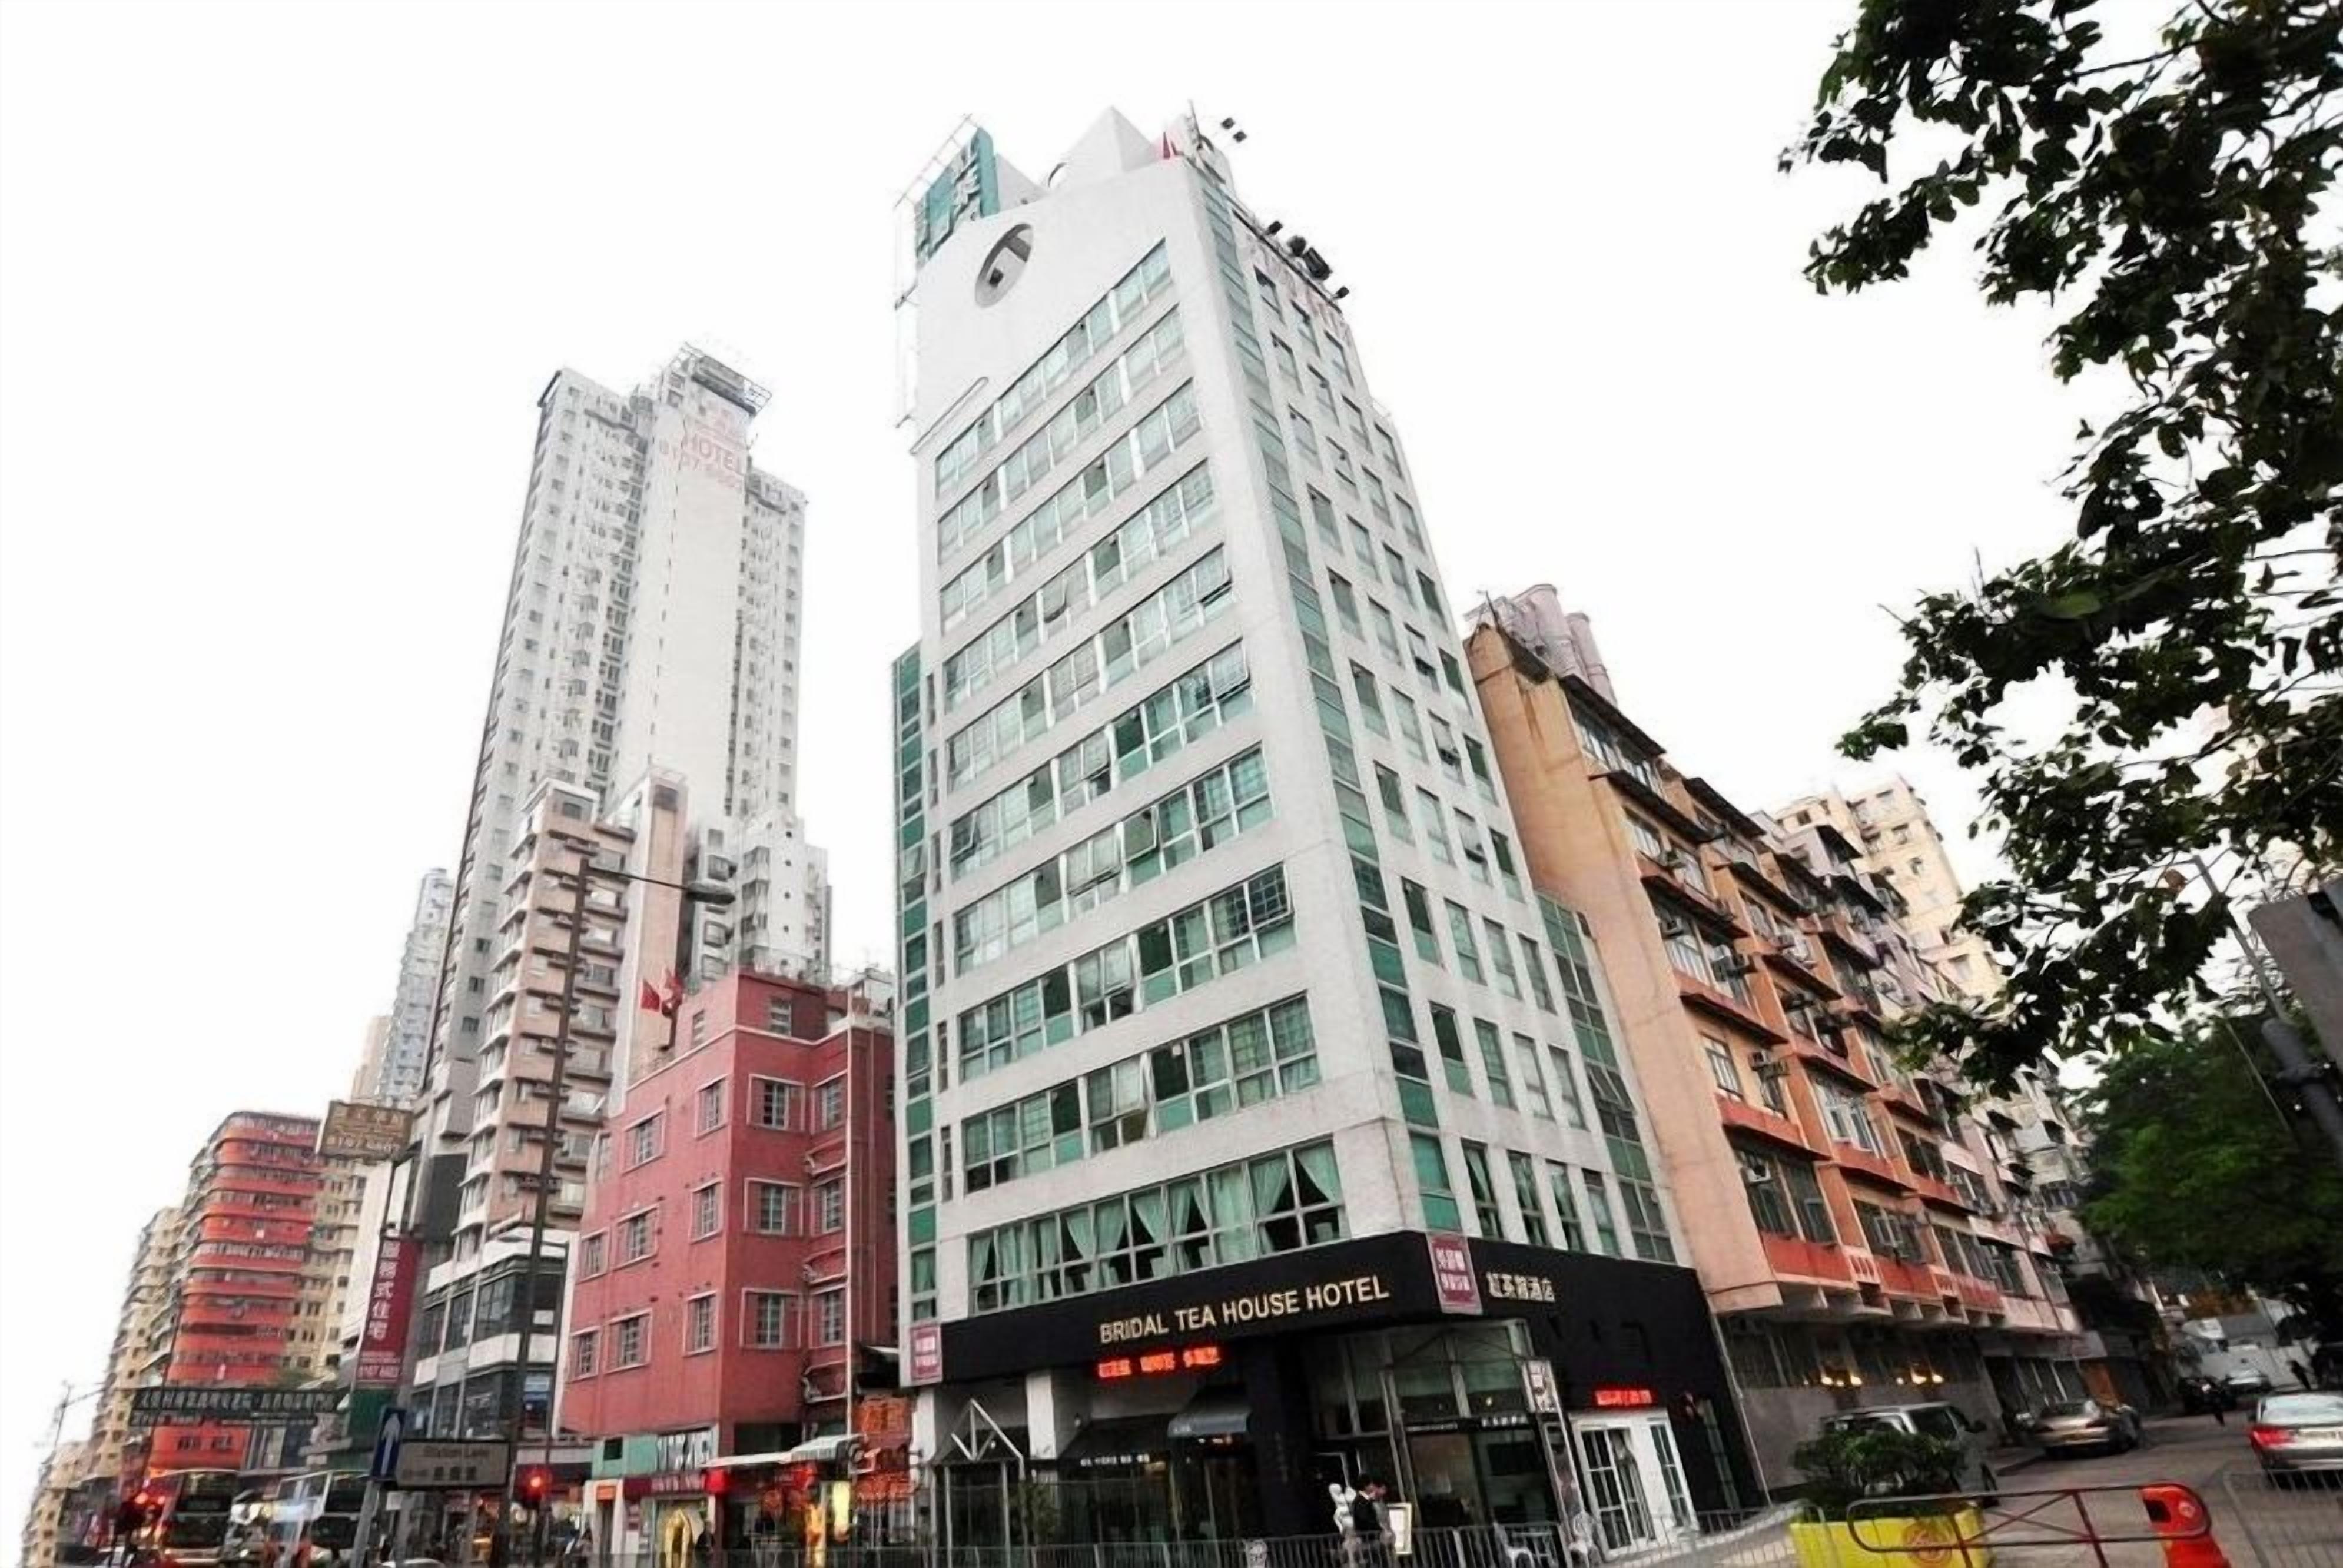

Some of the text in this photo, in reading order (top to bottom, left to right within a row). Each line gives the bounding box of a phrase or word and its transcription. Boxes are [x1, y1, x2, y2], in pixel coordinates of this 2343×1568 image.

[1100, 1274, 1389, 1344] BRIDAL TEA HOUSE HOTEL
